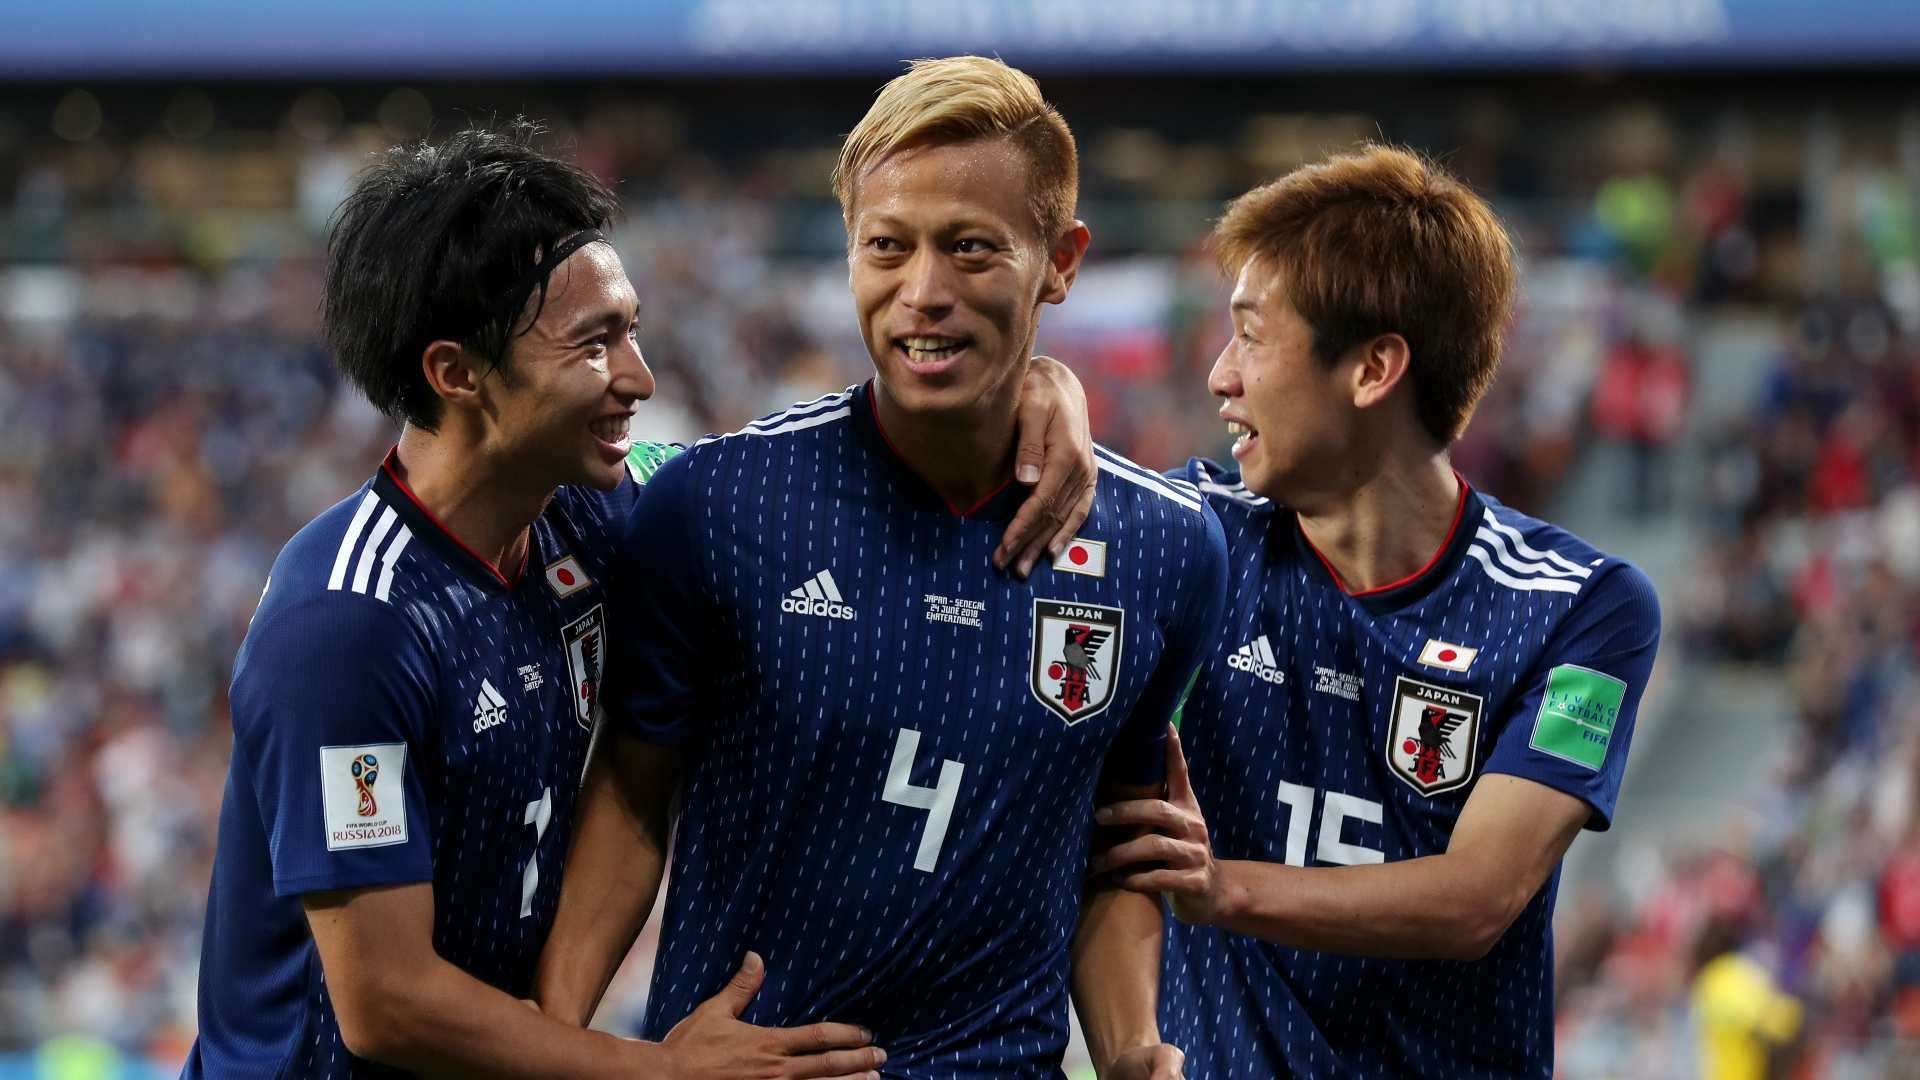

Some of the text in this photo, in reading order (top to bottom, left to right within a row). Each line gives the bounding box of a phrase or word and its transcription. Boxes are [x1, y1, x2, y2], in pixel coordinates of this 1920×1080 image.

[781, 597, 854, 620] adidas
[924, 594, 948, 605] JAPAN
[954, 598, 986, 611] SENEGAL
[930, 604, 979, 618] 24 JUNE 2018
[1057, 606, 1103, 620] JAPAN
[575, 615, 594, 636] JAPAN
[1227, 653, 1285, 685] adidas
[1416, 687, 1460, 705] JAPAN
[1551, 691, 1616, 717] LIVING
[473, 708, 507, 733] adida
[1583, 730, 1607, 745] FIFA
[881, 727, 965, 873] 4
[333, 825, 402, 841] RUSSIA 2018
